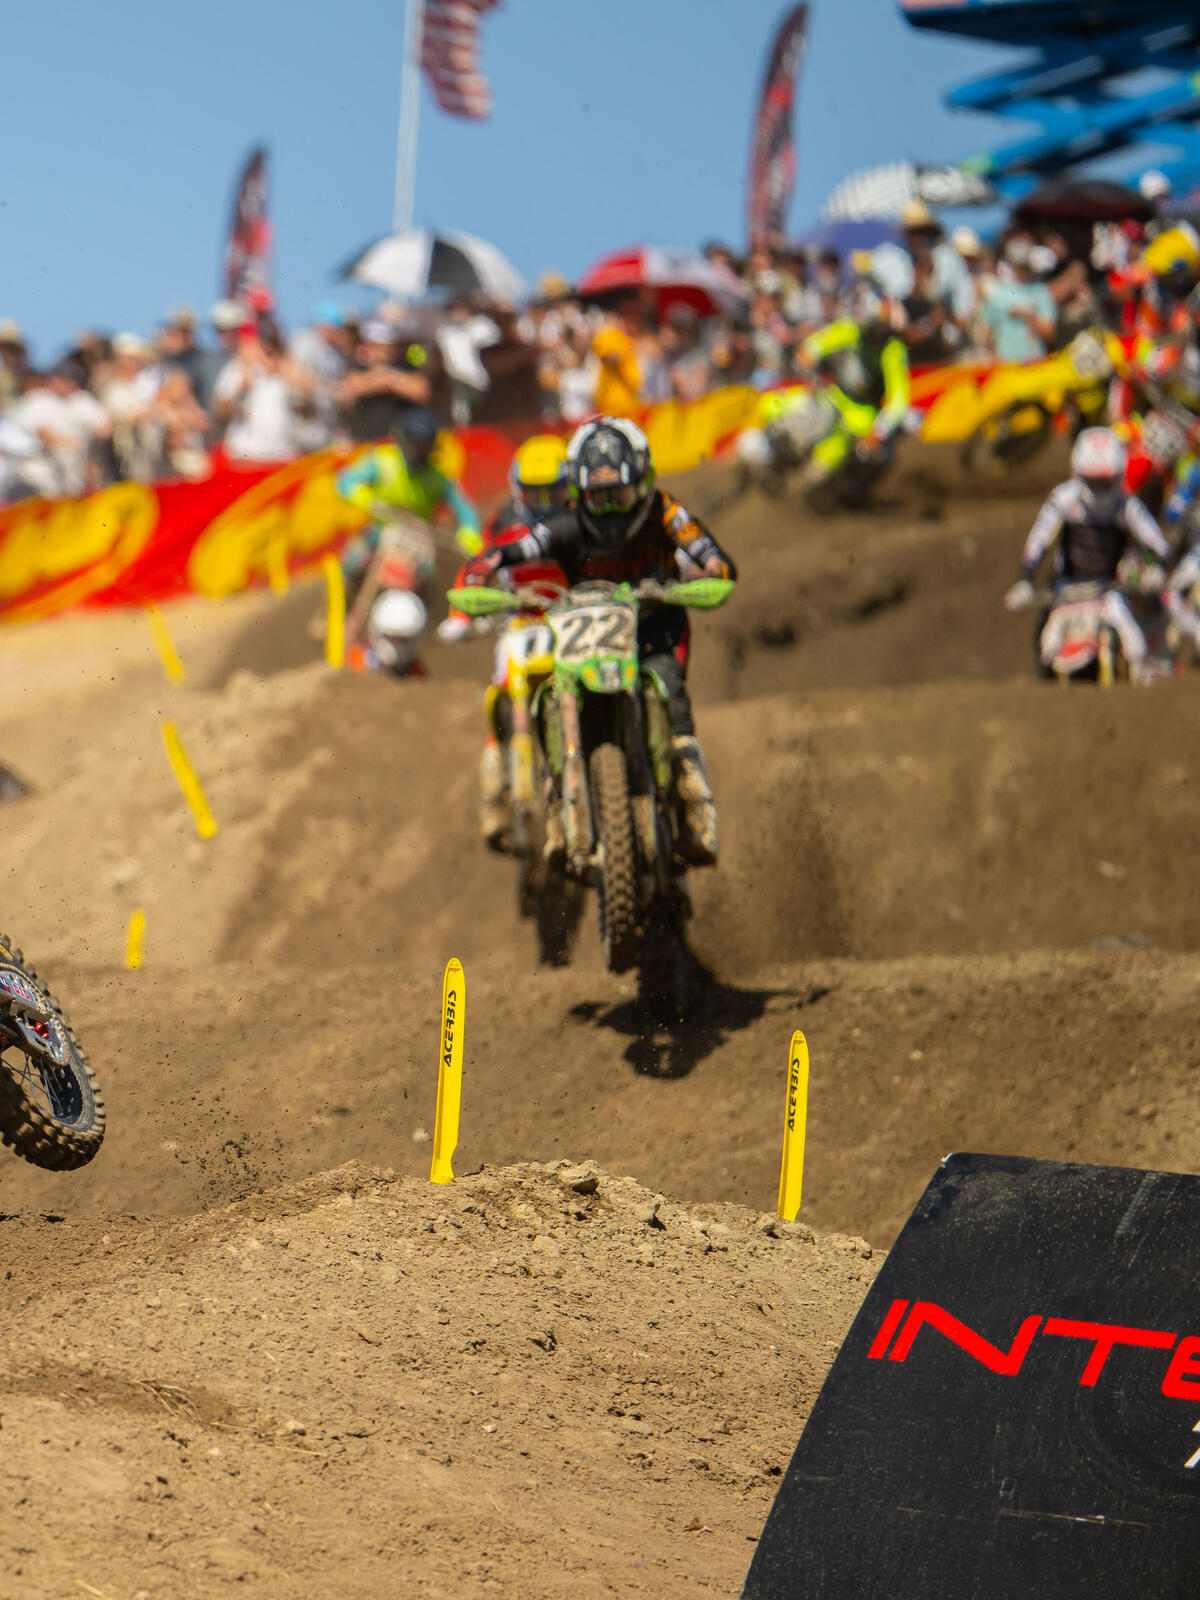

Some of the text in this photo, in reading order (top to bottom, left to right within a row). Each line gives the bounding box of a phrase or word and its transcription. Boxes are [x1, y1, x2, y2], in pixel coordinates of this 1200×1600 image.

[561, 614, 631, 658] 22
[443, 989, 457, 1068] ACERBIS
[788, 1057, 800, 1132] ACERBIS
